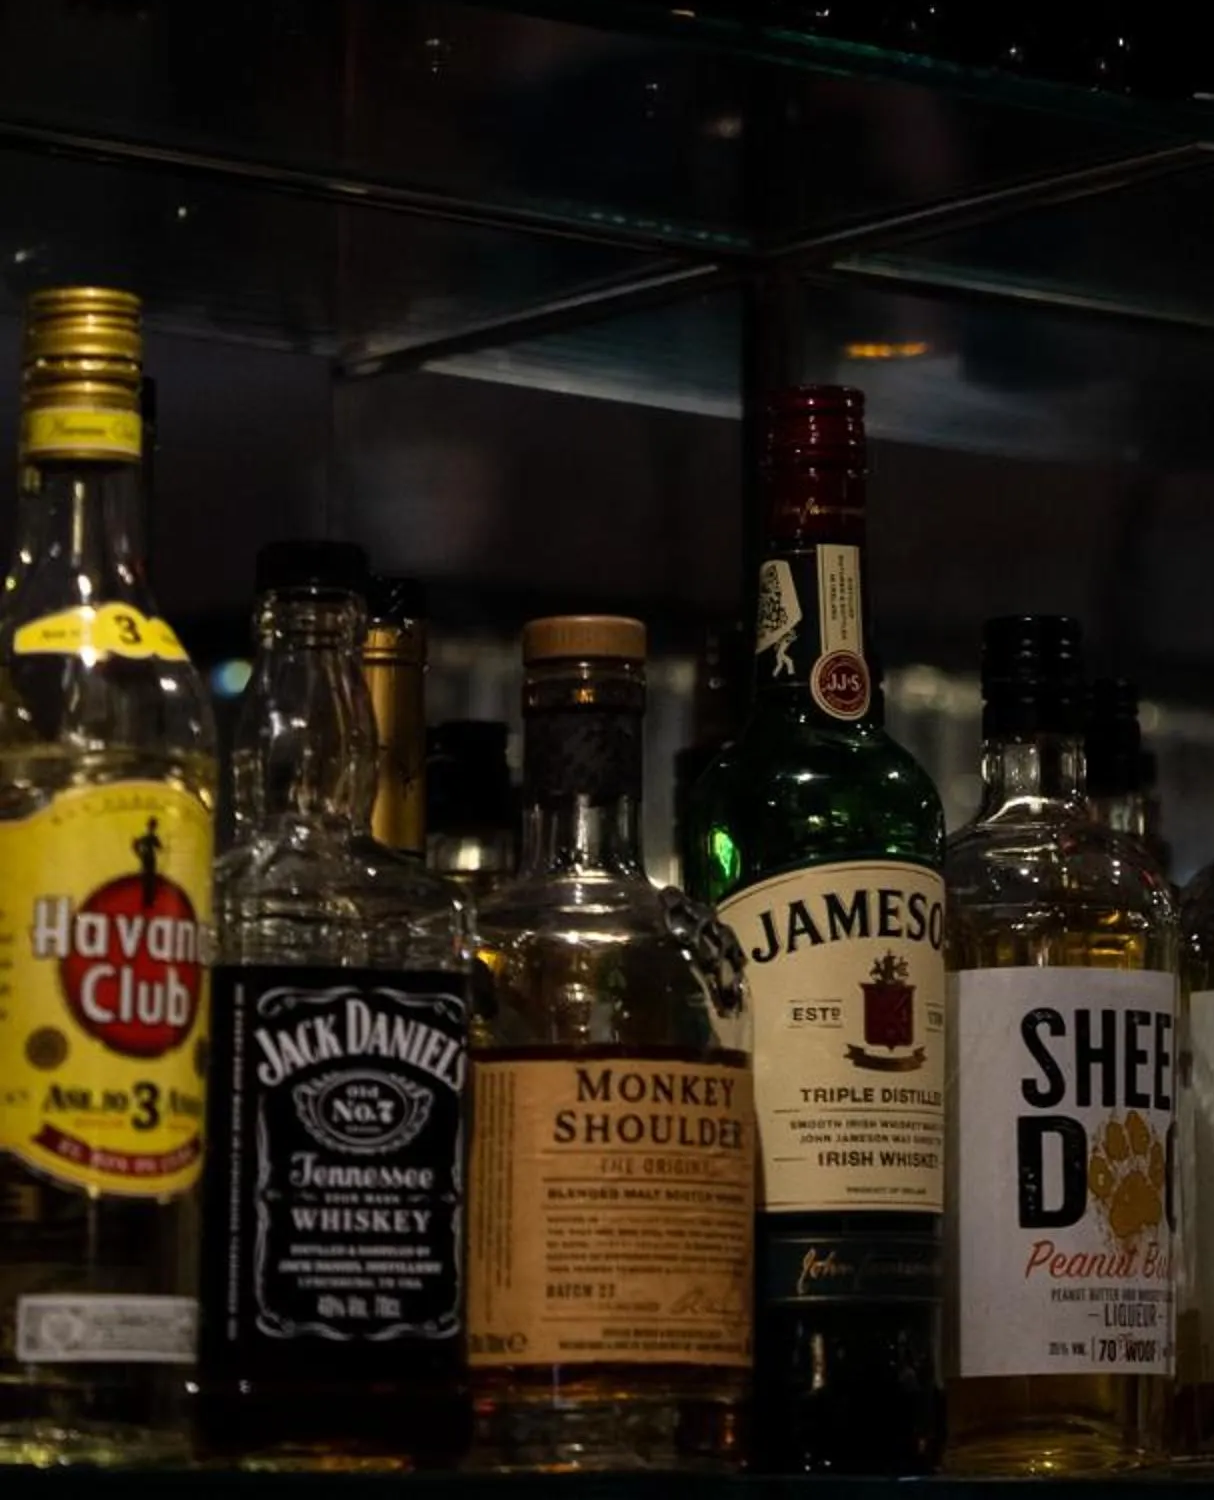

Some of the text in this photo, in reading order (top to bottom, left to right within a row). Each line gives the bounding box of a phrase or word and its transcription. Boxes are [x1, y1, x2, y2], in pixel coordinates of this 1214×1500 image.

[113, 614, 142, 646] 3
[751, 888, 944, 965] JAMESO
[81, 964, 191, 1027] Club
[254, 1013, 344, 1087] JACK
[131, 1081, 161, 1132] 3
[576, 1068, 736, 1108] MONKEY
[799, 1087, 876, 1105] TRIPLE
[288, 1151, 433, 1188] Tennessee
[816, 1150, 874, 1168] IRISH
[290, 1208, 432, 1234] WHISKEY
[1024, 1238, 1138, 1280] Peanut
